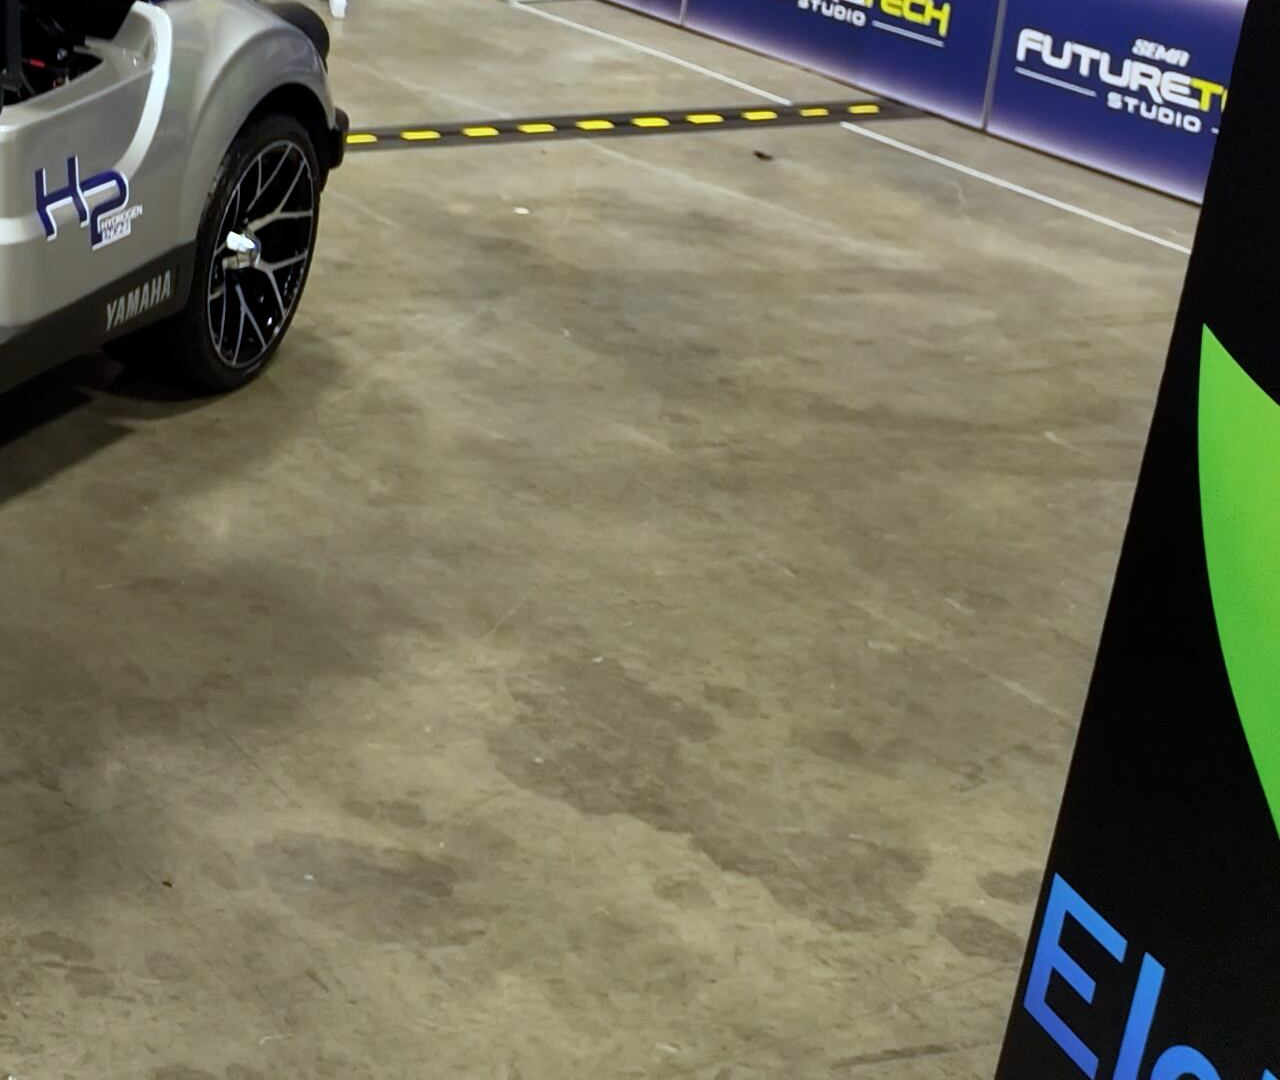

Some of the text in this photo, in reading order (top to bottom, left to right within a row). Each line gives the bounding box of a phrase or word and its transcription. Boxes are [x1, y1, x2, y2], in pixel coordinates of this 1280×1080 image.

[1015, 27, 1228, 113] FUTURET
[1106, 91, 1202, 134] STUDIO
[106, 270, 172, 331] YAMAHA
